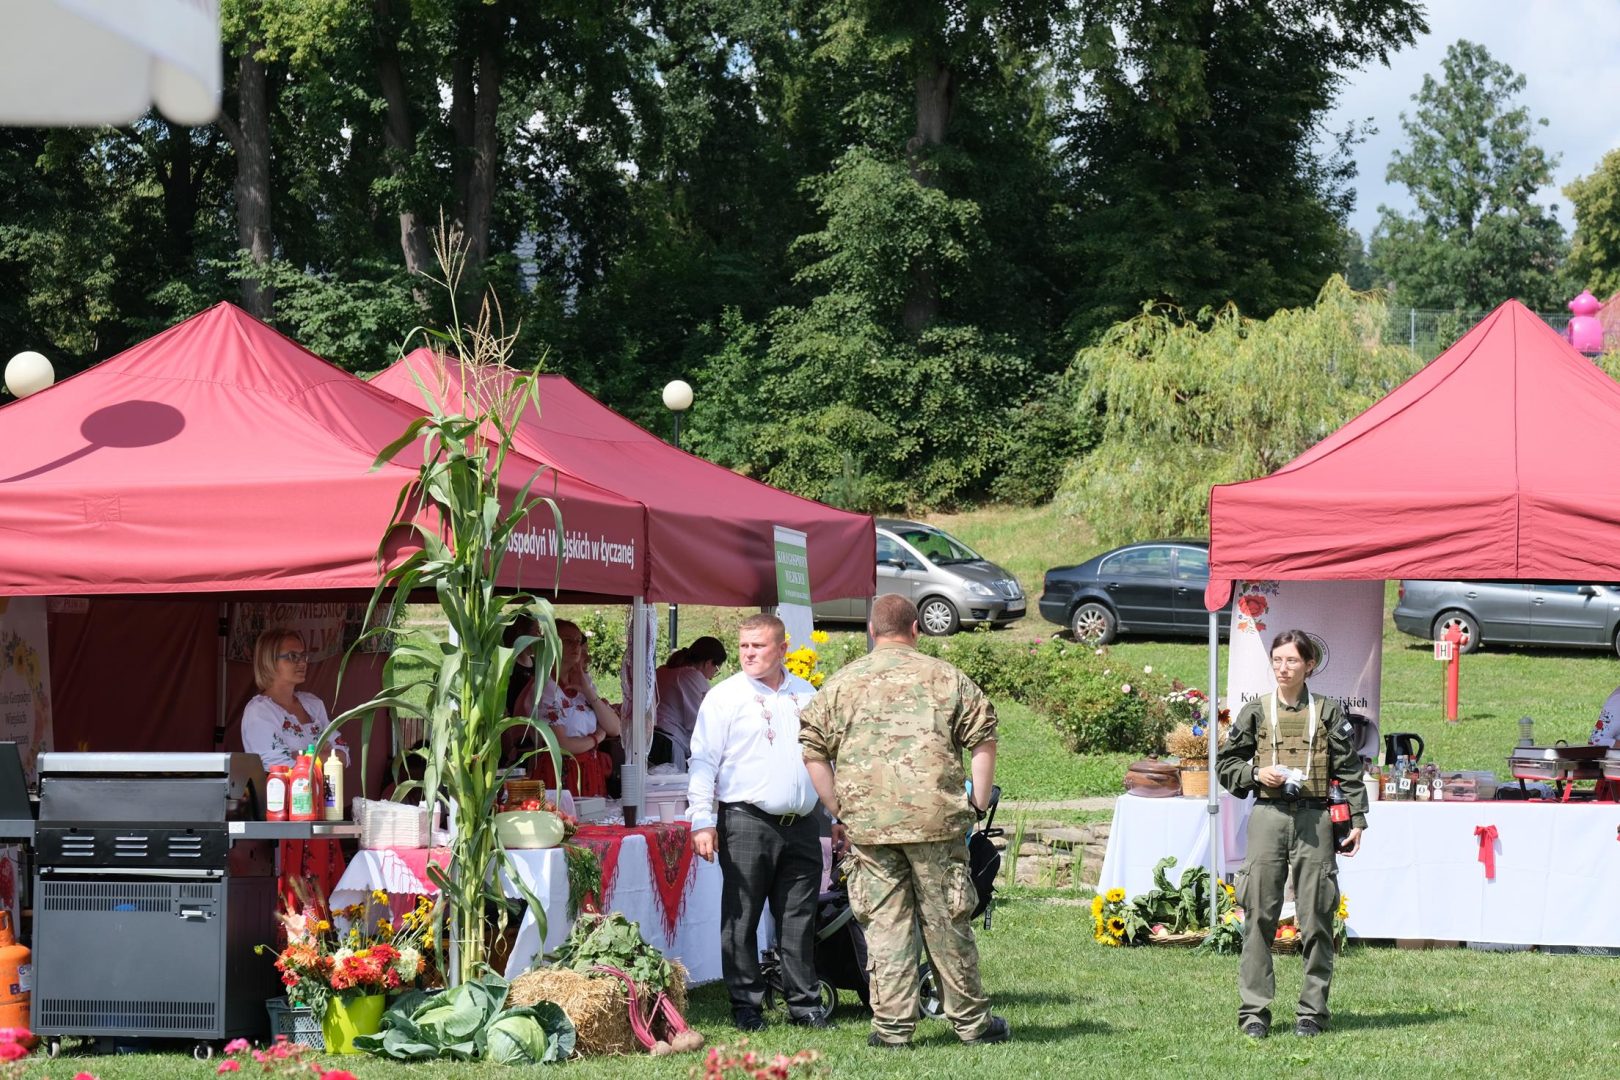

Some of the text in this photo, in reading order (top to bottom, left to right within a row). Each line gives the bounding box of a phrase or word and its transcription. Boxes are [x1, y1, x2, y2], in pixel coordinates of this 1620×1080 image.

[505, 526, 635, 570] ospodyń Wejskich w Łyczanej
[1440, 644, 1447, 657] H
